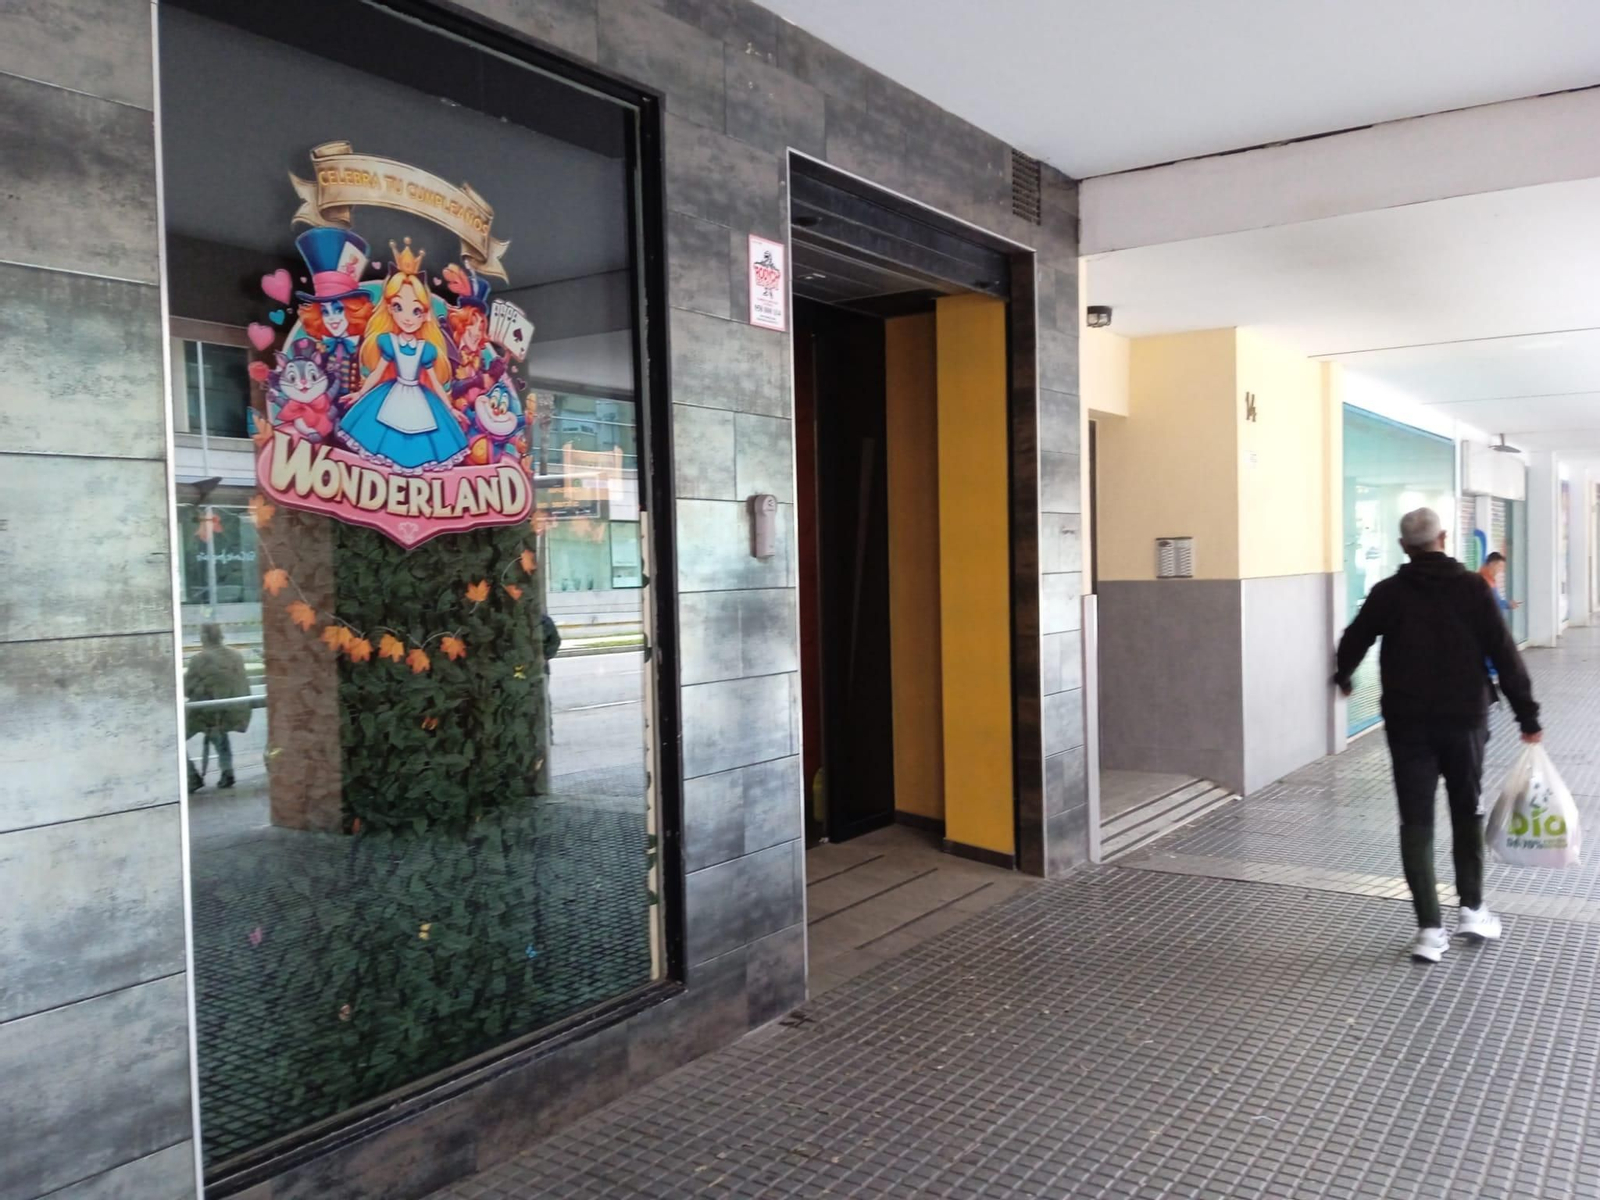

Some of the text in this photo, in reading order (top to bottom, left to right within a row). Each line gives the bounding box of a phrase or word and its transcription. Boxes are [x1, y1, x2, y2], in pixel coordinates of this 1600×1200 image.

[318, 167, 490, 236] CELEBRA TU CUMPLEAÑOS
[271, 431, 527, 519] WONDERLAND
